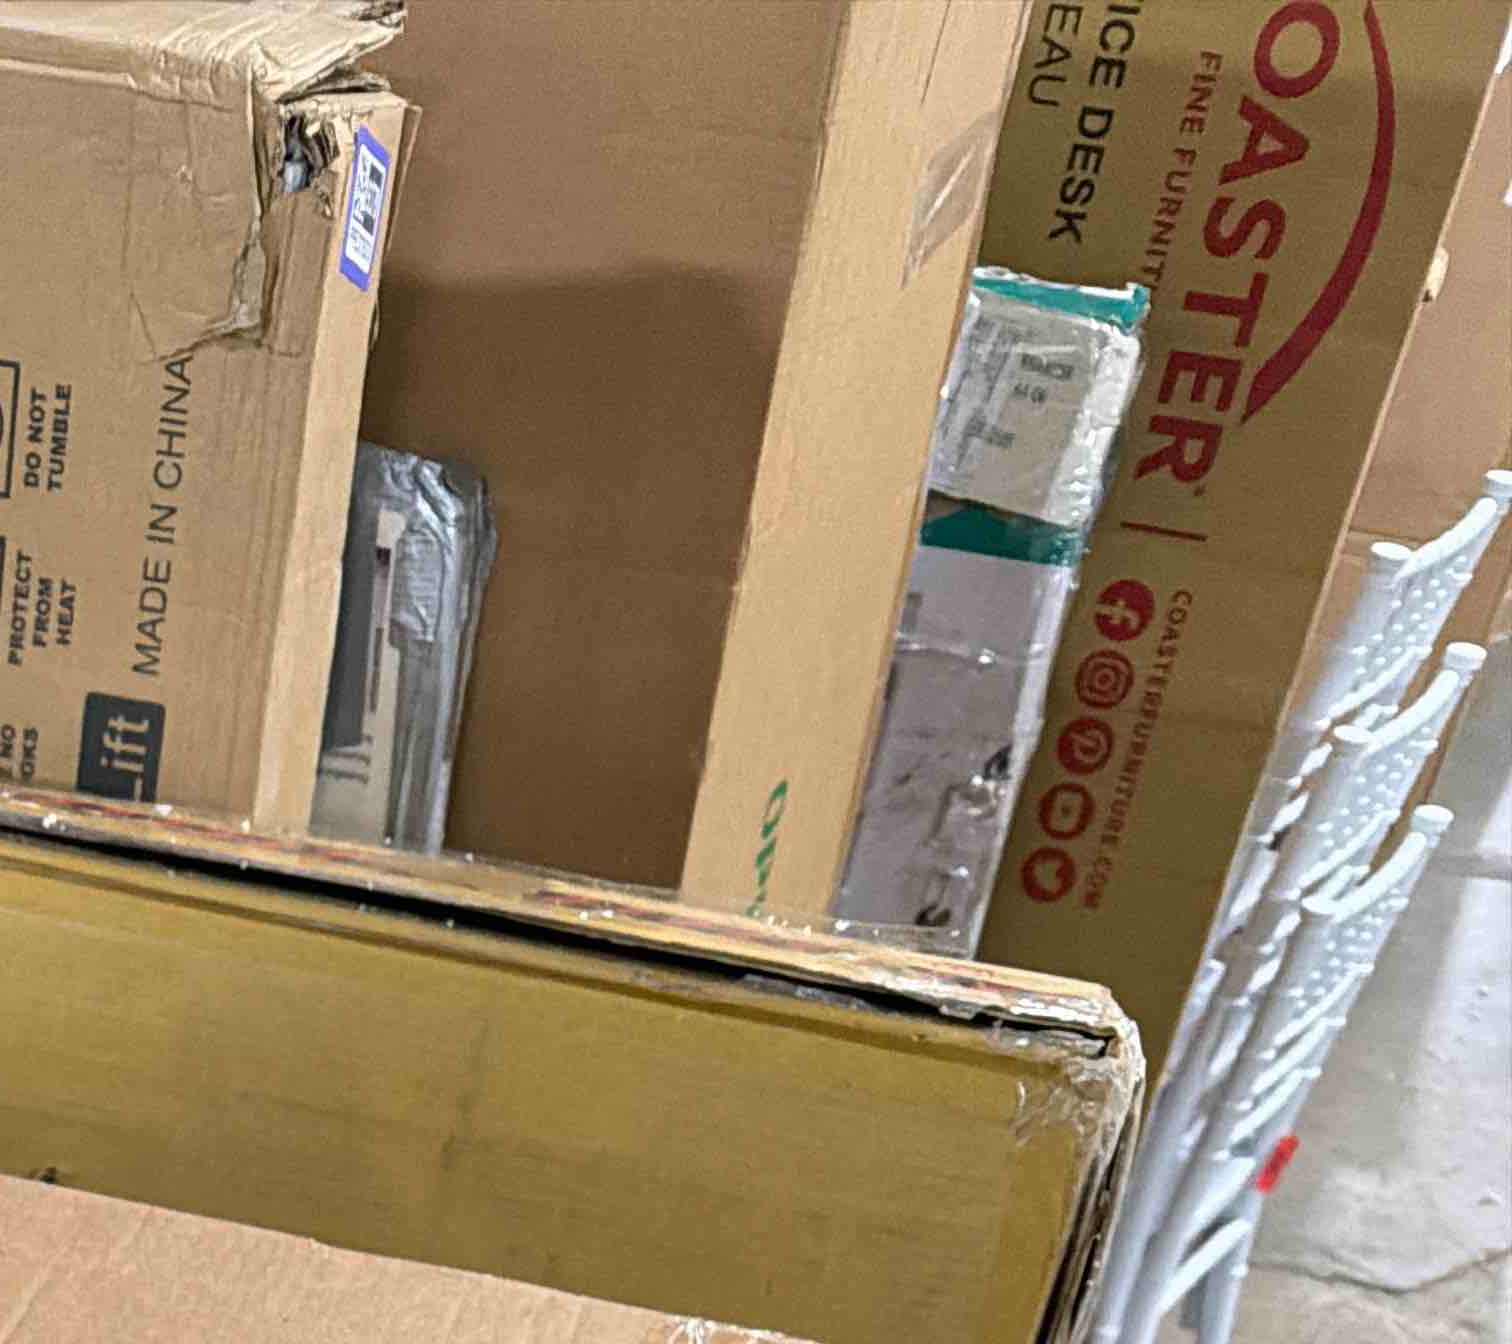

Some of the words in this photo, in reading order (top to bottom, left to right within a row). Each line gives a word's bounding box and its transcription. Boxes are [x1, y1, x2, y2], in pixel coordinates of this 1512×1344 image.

[1089, 0, 1145, 90] ICE
[1179, 49, 1223, 137] FINE
[1049, 106, 1115, 244] DESK
[1144, 148, 1197, 290] FURNIT
[28, 387, 51, 442] NOT
[47, 383, 73, 492] TUMBLE
[153, 353, 196, 491] CHINA
[24, 448, 45, 489] DO
[146, 502, 178, 546] IN
[7, 550, 34, 666] PROTECT
[32, 576, 54, 648] FROM
[55, 580, 78, 646] HEAT
[132, 557, 173, 677] MADE
